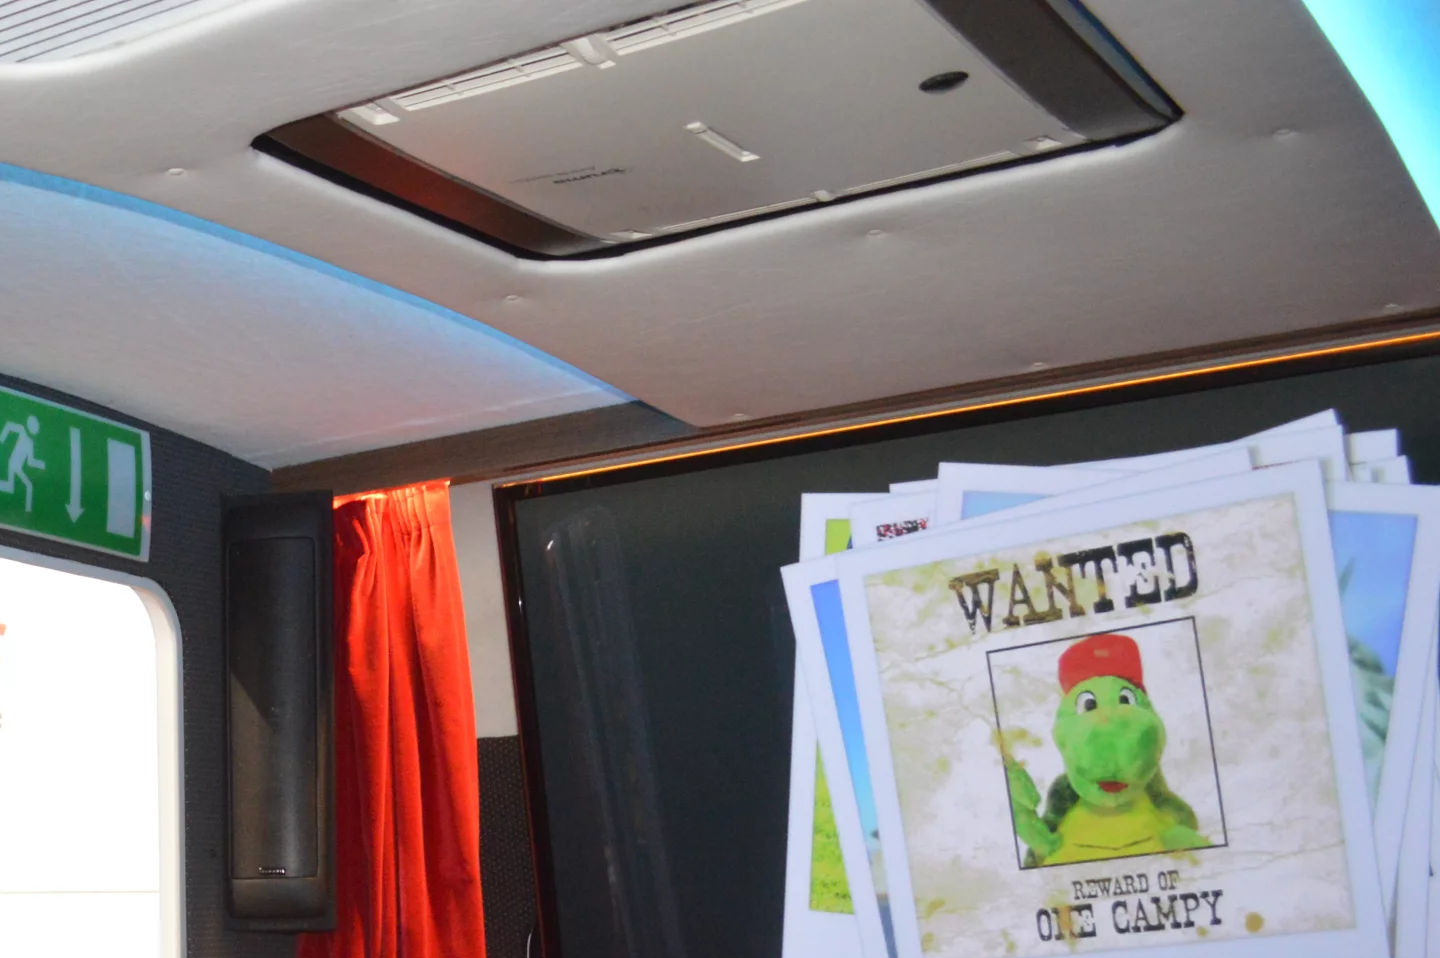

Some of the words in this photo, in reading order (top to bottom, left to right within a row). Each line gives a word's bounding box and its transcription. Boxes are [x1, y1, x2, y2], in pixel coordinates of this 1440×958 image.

[948, 531, 1198, 635] WANTED
[1071, 872, 1150, 900] REWARD
[1157, 869, 1181, 892] OF
[1110, 889, 1224, 935] CAMPY
